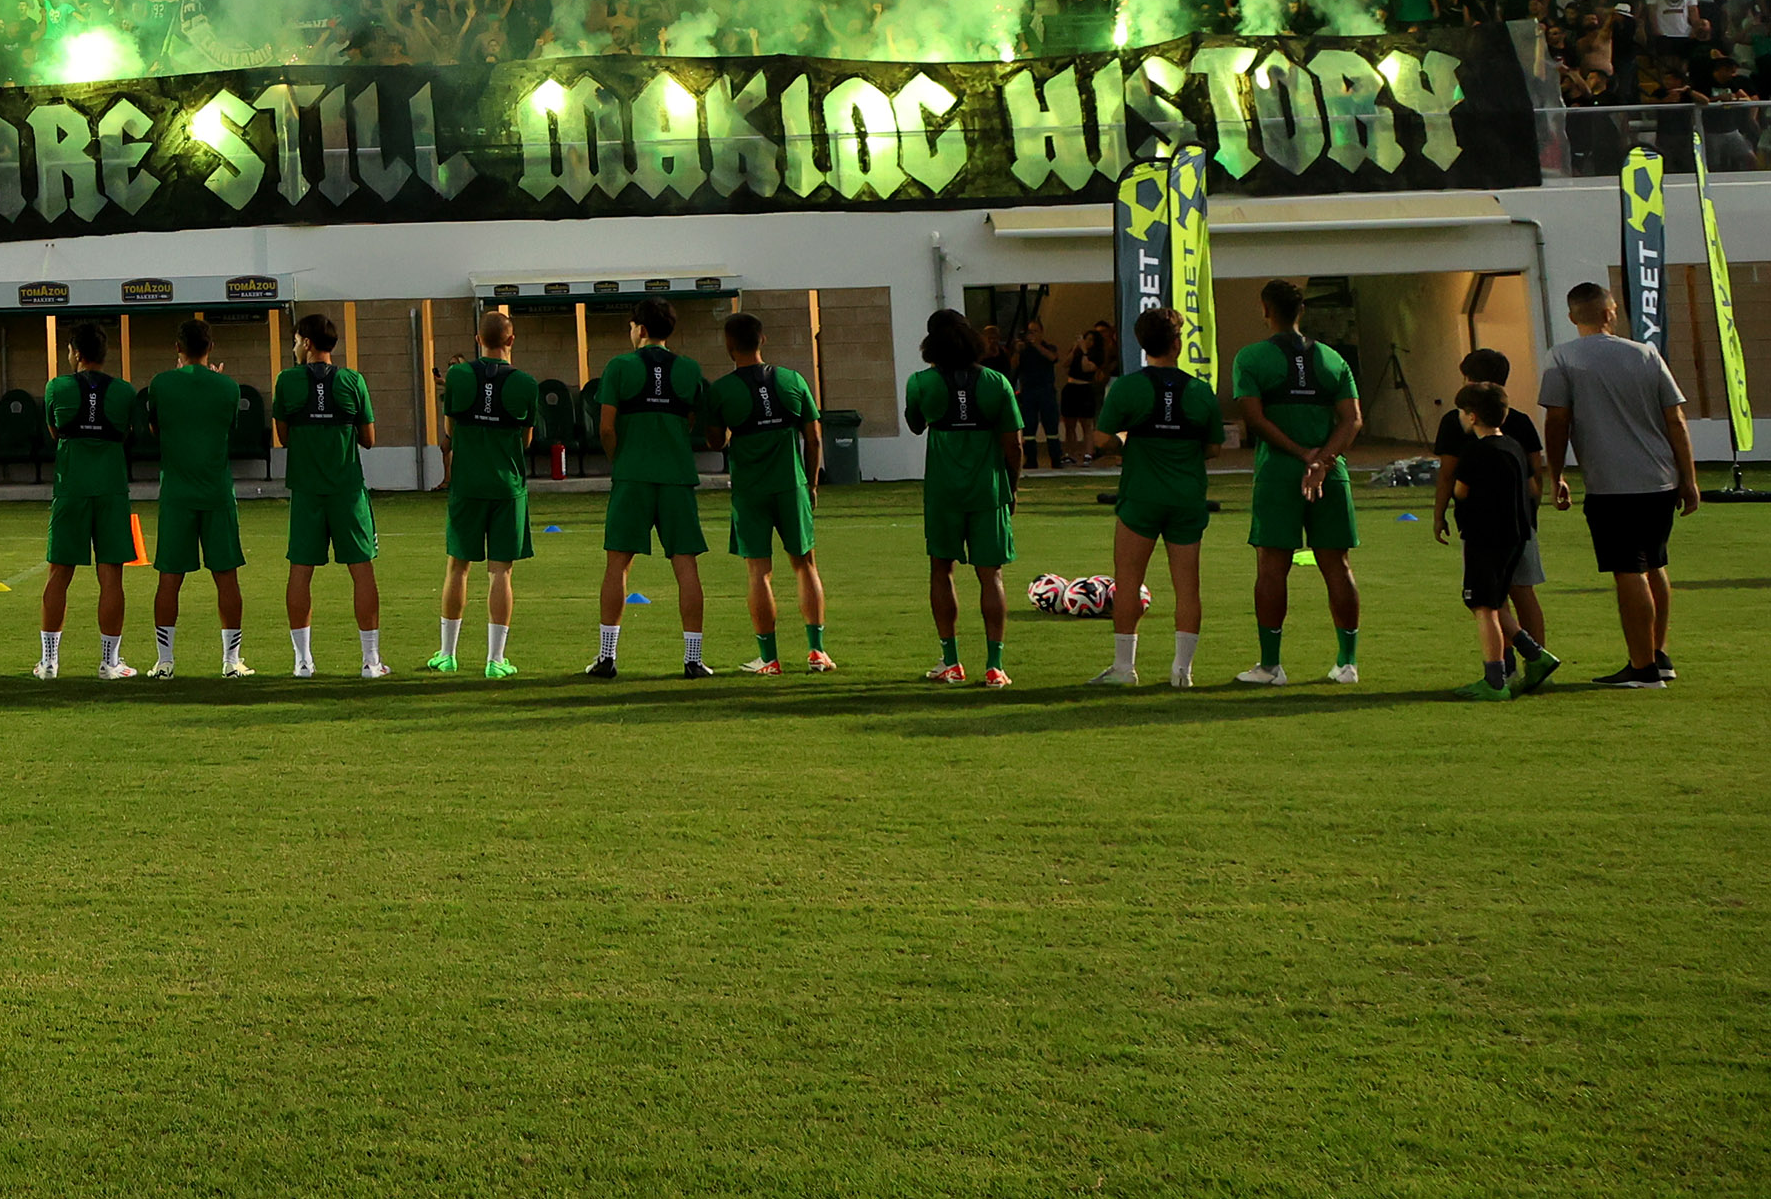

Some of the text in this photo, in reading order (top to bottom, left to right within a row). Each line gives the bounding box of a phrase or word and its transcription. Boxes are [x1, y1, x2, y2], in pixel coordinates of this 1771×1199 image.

[191, 81, 478, 210] STILL
[518, 70, 967, 203] MAKING
[1004, 47, 1465, 192] HISTORY
[20, 285, 67, 296] TOMAZOU
[124, 281, 171, 293] TOMAZOU
[228, 279, 276, 291] TOMAZOU
[1638, 240, 1660, 350] YBET
[654, 366, 662, 396] gpexe
[317, 383, 325, 411] gpexe
[484, 383, 493, 413] gpexe
[759, 386, 772, 417] gpexe
